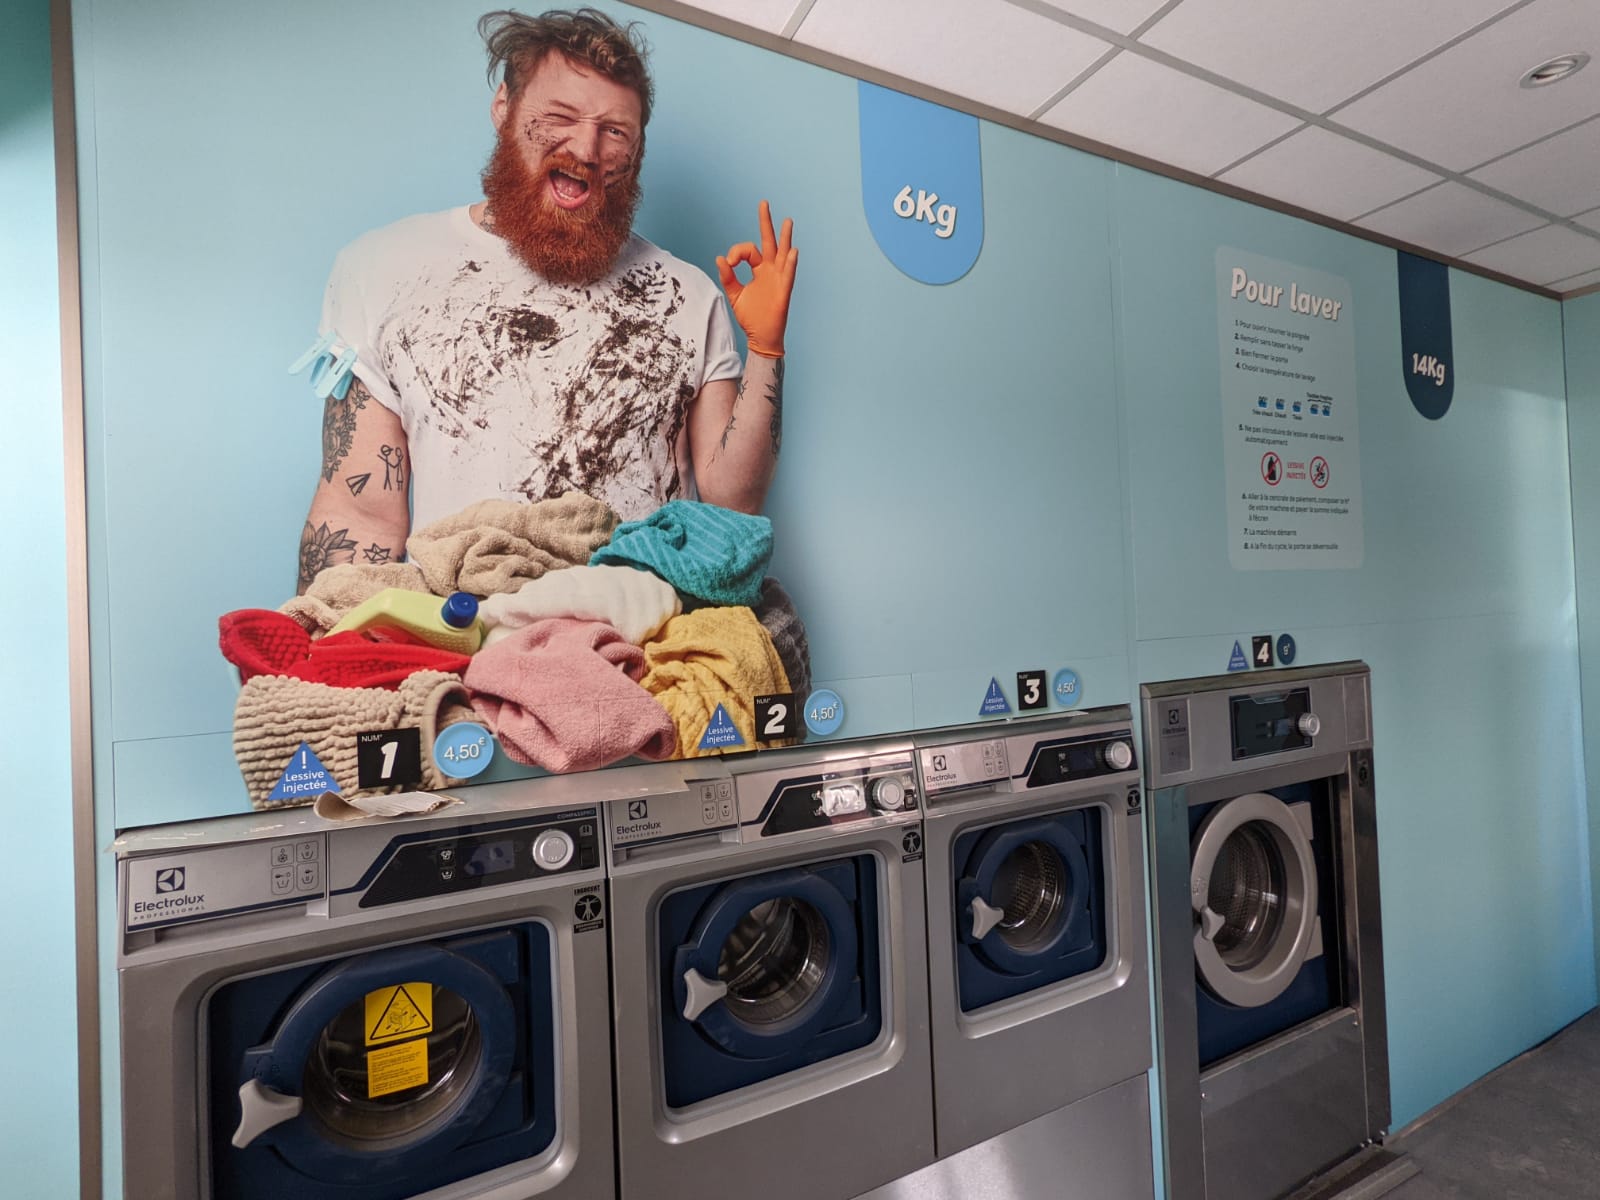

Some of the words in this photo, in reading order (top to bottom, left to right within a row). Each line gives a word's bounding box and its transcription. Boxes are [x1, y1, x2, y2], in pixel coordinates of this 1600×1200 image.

[893, 184, 958, 239] 6Kg
[1231, 266, 1284, 308] Pour
[1290, 283, 1342, 321] laver
[1412, 352, 1446, 386] 14Kg
[1257, 642, 1270, 663] 4
[1024, 678, 1041, 705] 3
[764, 703, 787, 735] 2
[810, 701, 840, 721] 4,50€
[706, 733, 736, 744] injectée
[708, 725, 734, 736] Lessive
[381, 741, 398, 779] 1
[443, 737, 487, 763] 4,50€
[285, 769, 325, 783] Lessive
[283, 779, 328, 794] injectée
[616, 822, 662, 835] Electrolux
[134, 894, 205, 913] Electrolux
[134, 905, 205, 921] PROFESSIONAL
